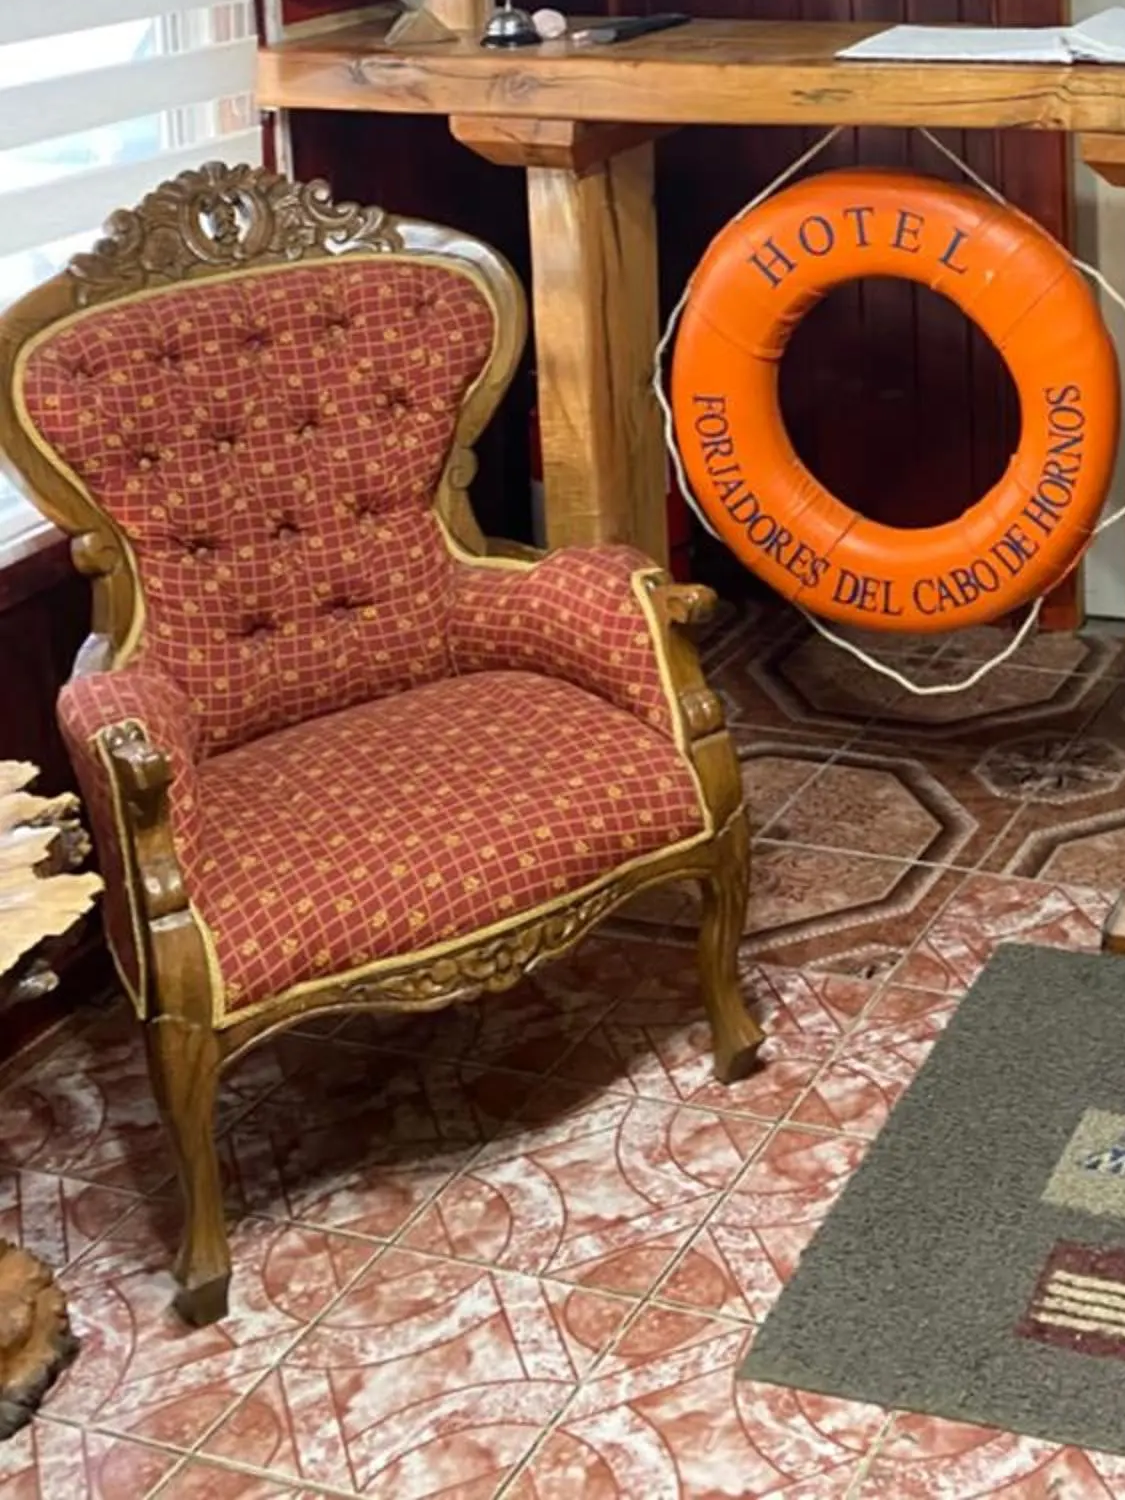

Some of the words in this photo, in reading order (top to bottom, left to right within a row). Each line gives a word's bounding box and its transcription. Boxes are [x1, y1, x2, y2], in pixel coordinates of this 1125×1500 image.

[748, 206, 970, 288] HOTEL
[693, 394, 830, 588] FORJADORES
[832, 569, 905, 616] DEL
[912, 559, 1001, 616] CABO
[992, 523, 1040, 577] DE
[1020, 384, 1086, 537] HORNOS
